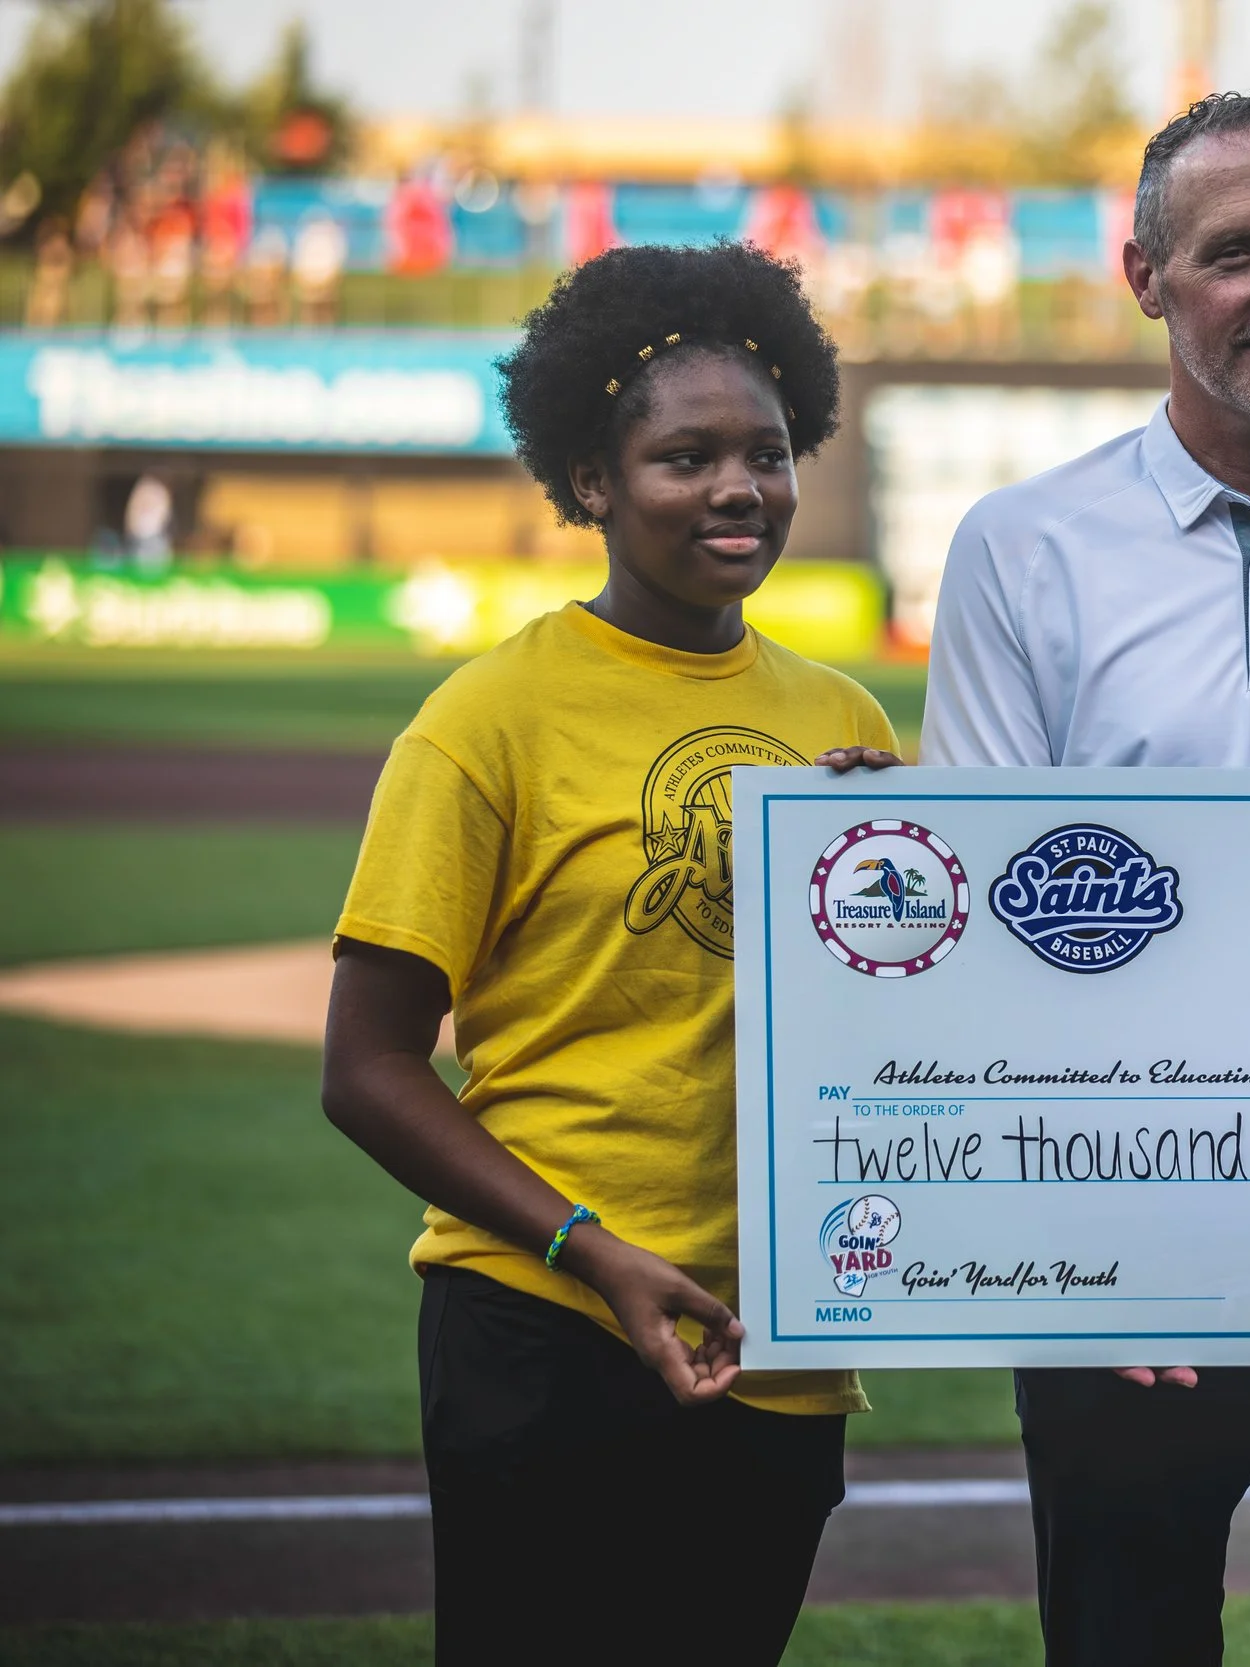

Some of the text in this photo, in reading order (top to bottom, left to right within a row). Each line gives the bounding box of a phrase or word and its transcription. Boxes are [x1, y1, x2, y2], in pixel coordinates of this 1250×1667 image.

[663, 752, 704, 802] ATHLETES
[1077, 836, 1119, 859] PAUL
[994, 855, 1174, 918] Saints
[696, 898, 711, 919] TO
[833, 898, 946, 919] Treasure Island
[1050, 934, 1132, 961] BASEBALL
[818, 1085, 851, 1101] PAY
[873, 1059, 976, 1085] Athletes
[983, 1059, 1122, 1085] Committed
[1119, 1069, 1141, 1084] to
[853, 1104, 965, 1117] TO THE ORDER OF
[1002, 1112, 1248, 1182] thousand
[829, 1247, 893, 1275] YARD
[879, 1268, 899, 1277] YOUTH
[959, 1261, 1024, 1295] Yard
[1017, 1261, 1048, 1295] for
[1050, 1261, 1119, 1295] Youth
[815, 1307, 872, 1322] MEMO
